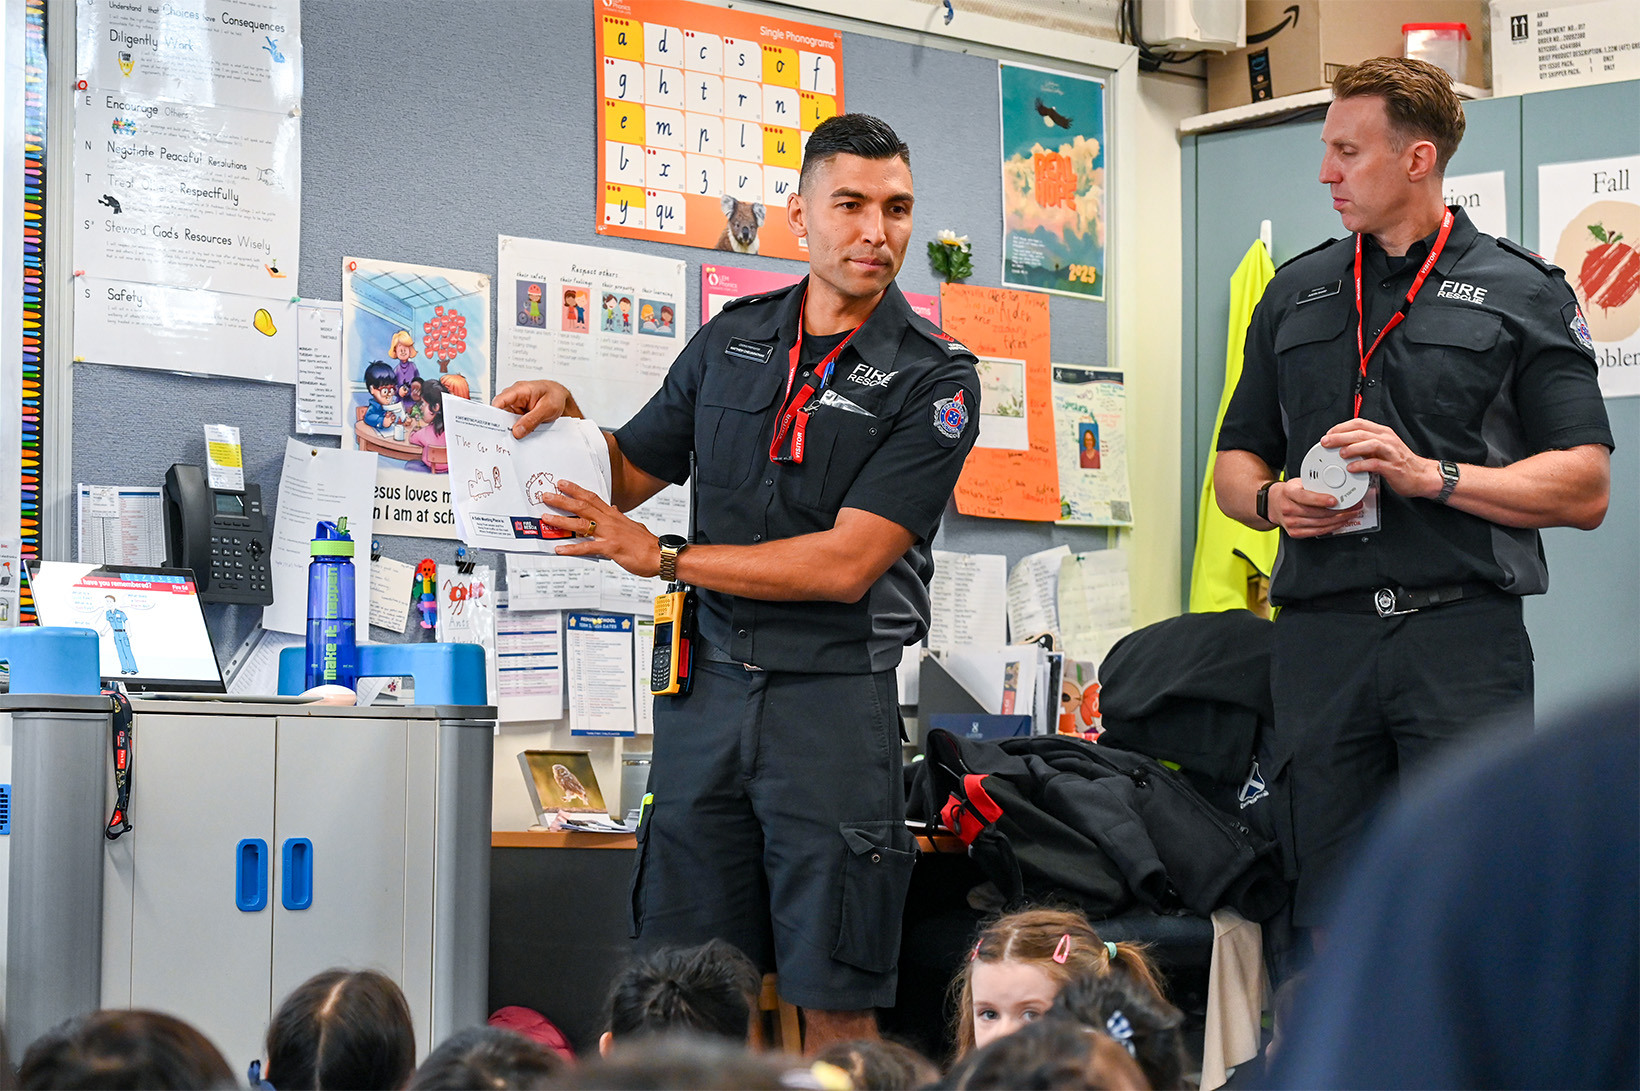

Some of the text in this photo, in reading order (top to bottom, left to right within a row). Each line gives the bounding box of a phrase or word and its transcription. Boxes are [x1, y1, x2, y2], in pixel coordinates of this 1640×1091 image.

[109, 1, 142, 12] Understand
[162, 4, 200, 19] Choices
[222, 12, 285, 33] Consequences
[110, 29, 158, 51] Diligently
[164, 36, 194, 51] Work
[760, 26, 835, 49] Single Phonograms
[1538, 26, 1566, 36] DEPARTMENT
[1538, 36, 1552, 44] ORDER
[618, 28, 821, 90] a d c s o f
[618, 69, 820, 119] g h t r n i
[86, 96, 189, 118] E Encourage Others
[621, 115, 786, 154] e m p l u
[85, 141, 247, 170] N Negotiate Peaceful Resolutions
[659, 163, 670, 177] x
[738, 175, 748, 188] v
[775, 181, 789, 194] w
[1593, 169, 1630, 194] Fall
[85, 174, 91, 183] T
[108, 174, 134, 188] Treat
[180, 183, 239, 206] Respectfully
[1444, 189, 1480, 208] tion
[620, 200, 628, 224] y
[656, 204, 674, 229] qu
[105, 220, 146, 235] Steward
[153, 225, 179, 239] God's
[185, 228, 232, 245] Resources
[238, 235, 270, 255] Wisely
[571, 264, 618, 278] Respect others
[1420, 251, 1437, 274] VISITOR
[574, 277, 593, 286] feelings
[1069, 263, 1096, 284] 2025
[85, 288, 143, 308] S Safety
[653, 288, 673, 298] learning
[1437, 290, 1485, 304] RESCUE
[1440, 280, 1488, 298] FIRE
[1597, 348, 1640, 367] oble
[852, 363, 899, 381] FIRE
[779, 414, 791, 439] VISITOR
[455, 434, 471, 448] The
[374, 485, 451, 503] esus loves m
[373, 505, 454, 524] n I am at sch
[324, 567, 338, 680] make it happen
[449, 616, 469, 627] Ants
